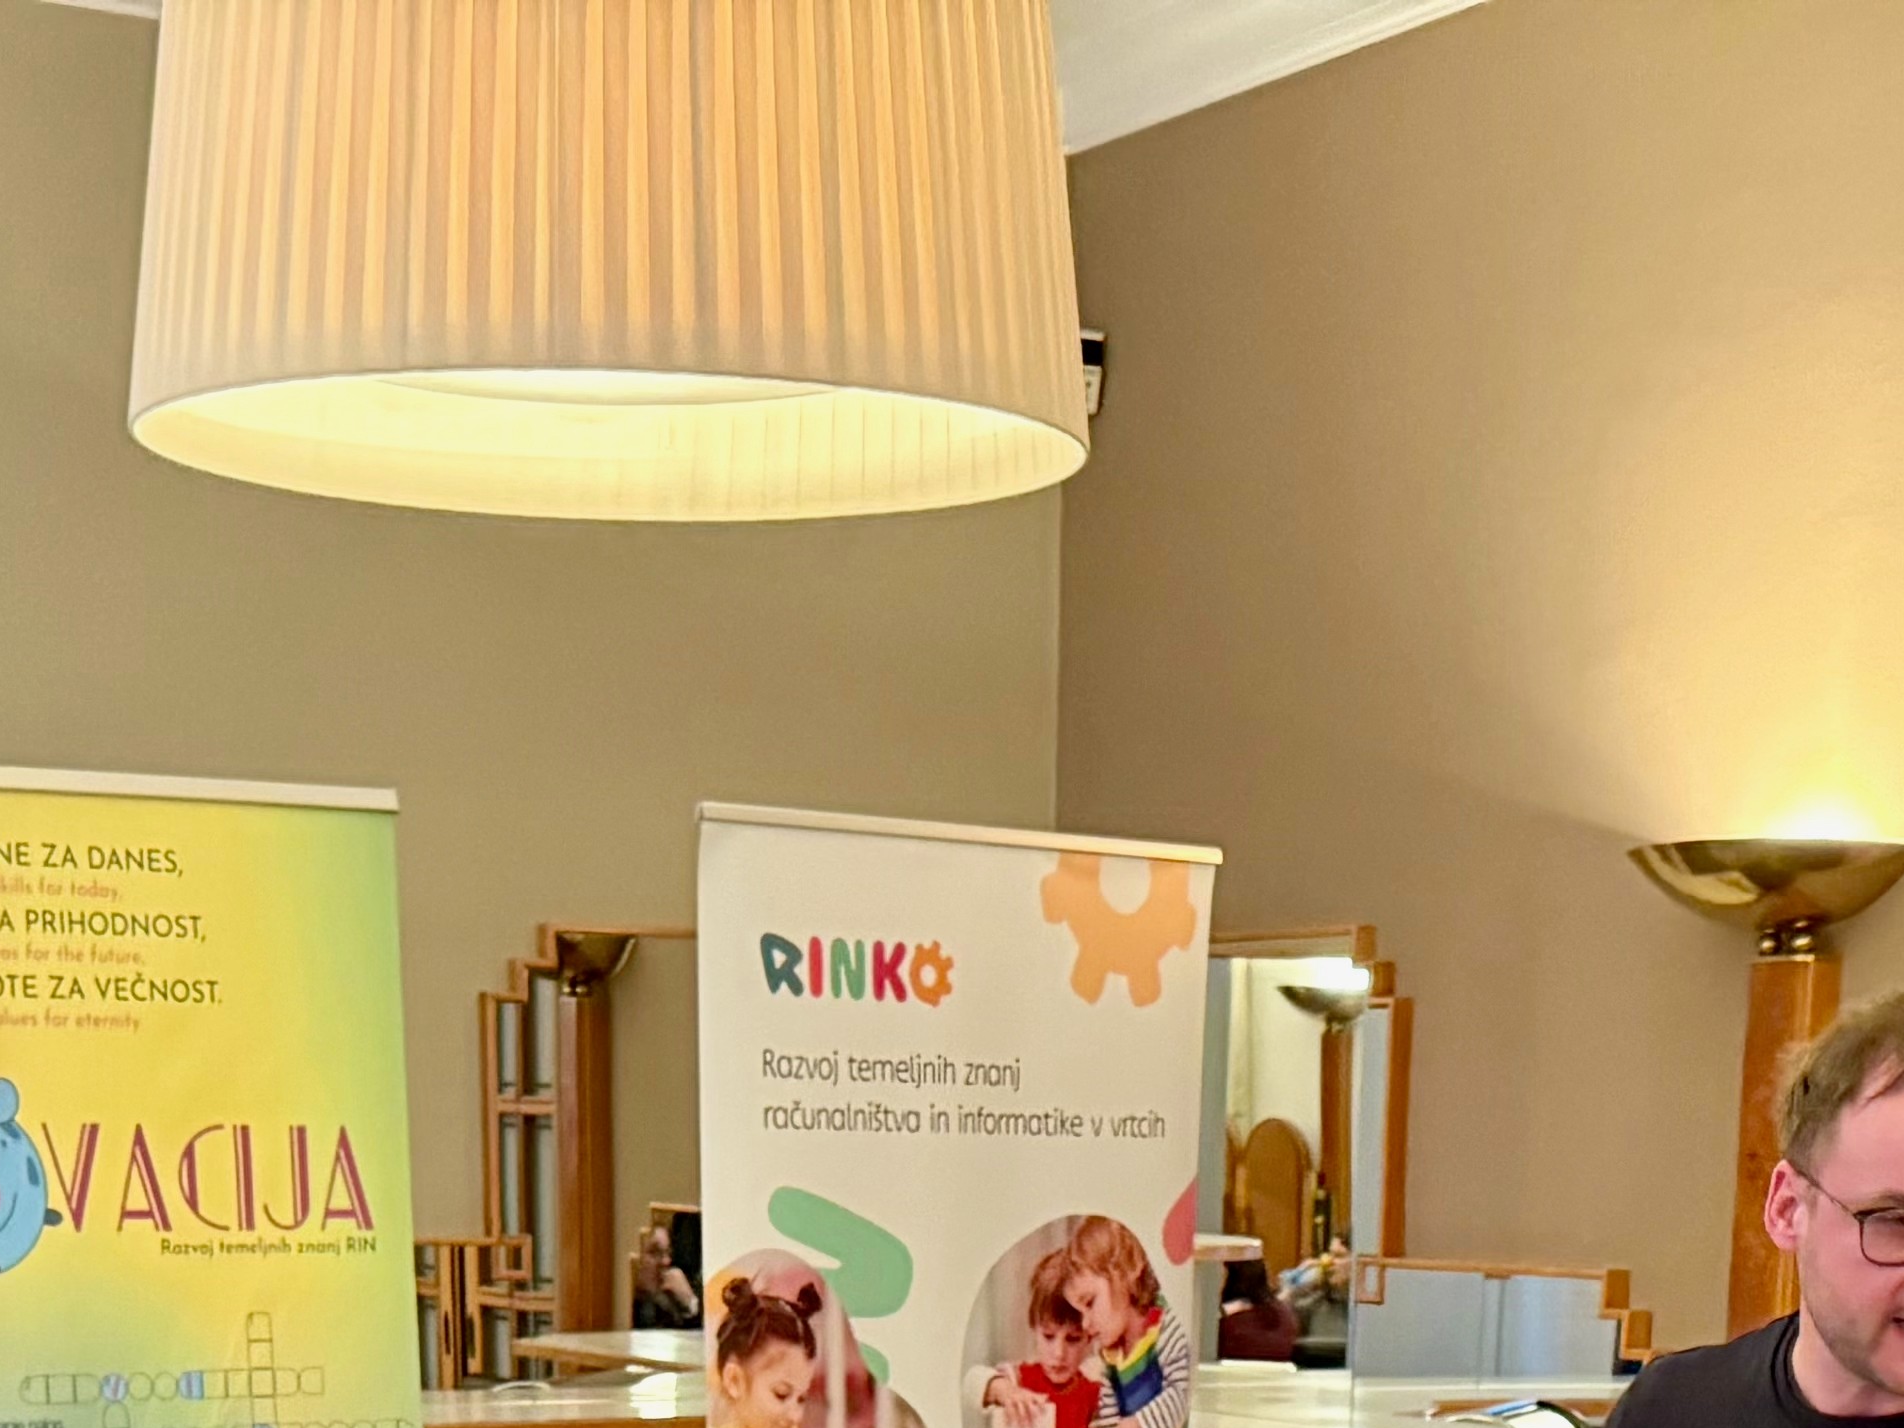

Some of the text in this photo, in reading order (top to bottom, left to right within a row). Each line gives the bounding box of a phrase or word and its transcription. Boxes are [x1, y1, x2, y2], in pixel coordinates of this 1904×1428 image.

[41, 842, 78, 869] ZA
[87, 845, 183, 878] DANES,
[38, 876, 63, 897] for
[25, 909, 206, 943] PRIHODNOST,
[25, 943, 50, 962] for
[57, 944, 85, 963] the
[760, 932, 955, 1007] RINKO
[48, 974, 86, 1000] ZA
[94, 971, 224, 1005] VEČNOST.
[44, 1007, 70, 1028] for
[761, 1048, 1021, 1092] Razvoj temeljnih znanj
[763, 1100, 1166, 1138] računalništva in informatike v vrtcih
[160, 1236, 378, 1258] Razvoj temeljnih znanj RIN
